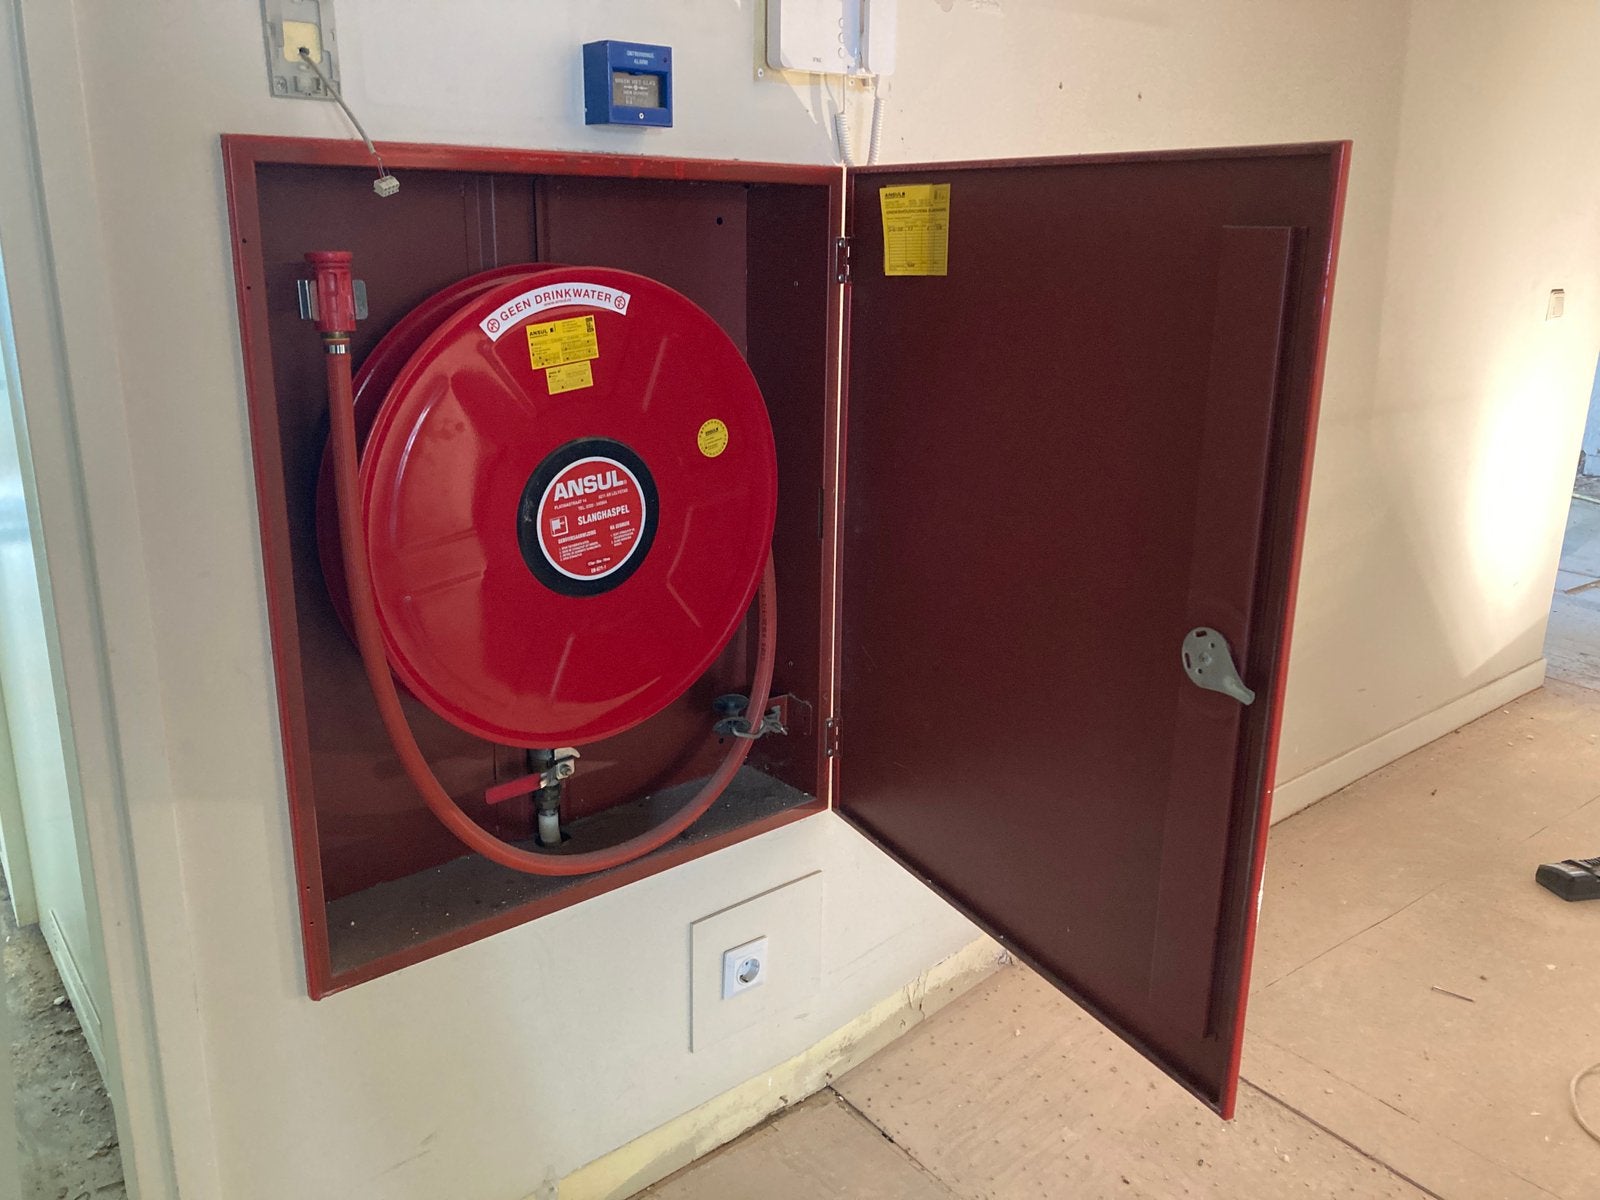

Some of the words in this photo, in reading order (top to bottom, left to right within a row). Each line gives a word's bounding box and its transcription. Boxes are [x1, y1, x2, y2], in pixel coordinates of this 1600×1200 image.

[500, 298, 531, 321] GEEN
[534, 288, 612, 305] DRINKWATER
[554, 470, 624, 501] ANSUL
[578, 505, 630, 526] SLANGHASPEL
